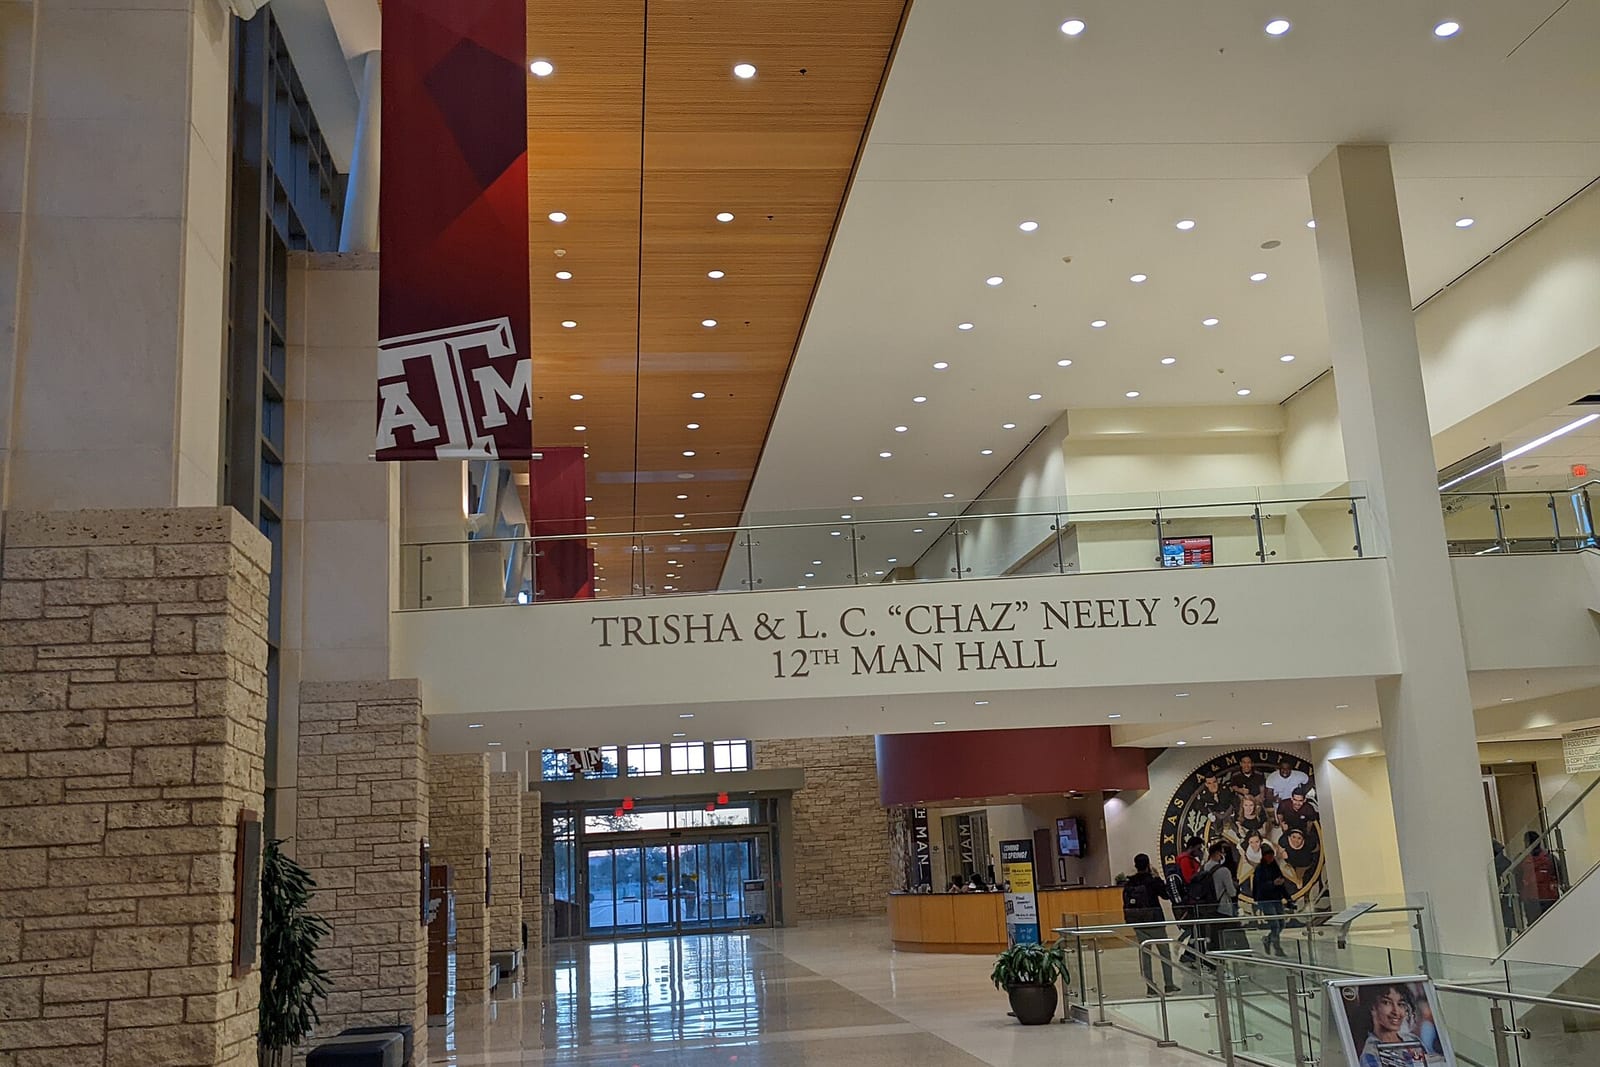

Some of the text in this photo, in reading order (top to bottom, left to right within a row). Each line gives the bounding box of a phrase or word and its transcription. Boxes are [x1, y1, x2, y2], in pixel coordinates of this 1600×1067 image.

[591, 595, 1219, 647] TRISHA & L. C. “CHAZ” NEELY ’62
[772, 639, 1058, 678] 12TH MAN HALL
[915, 826, 929, 865] MAN
[1163, 798, 1185, 865] EXAS
